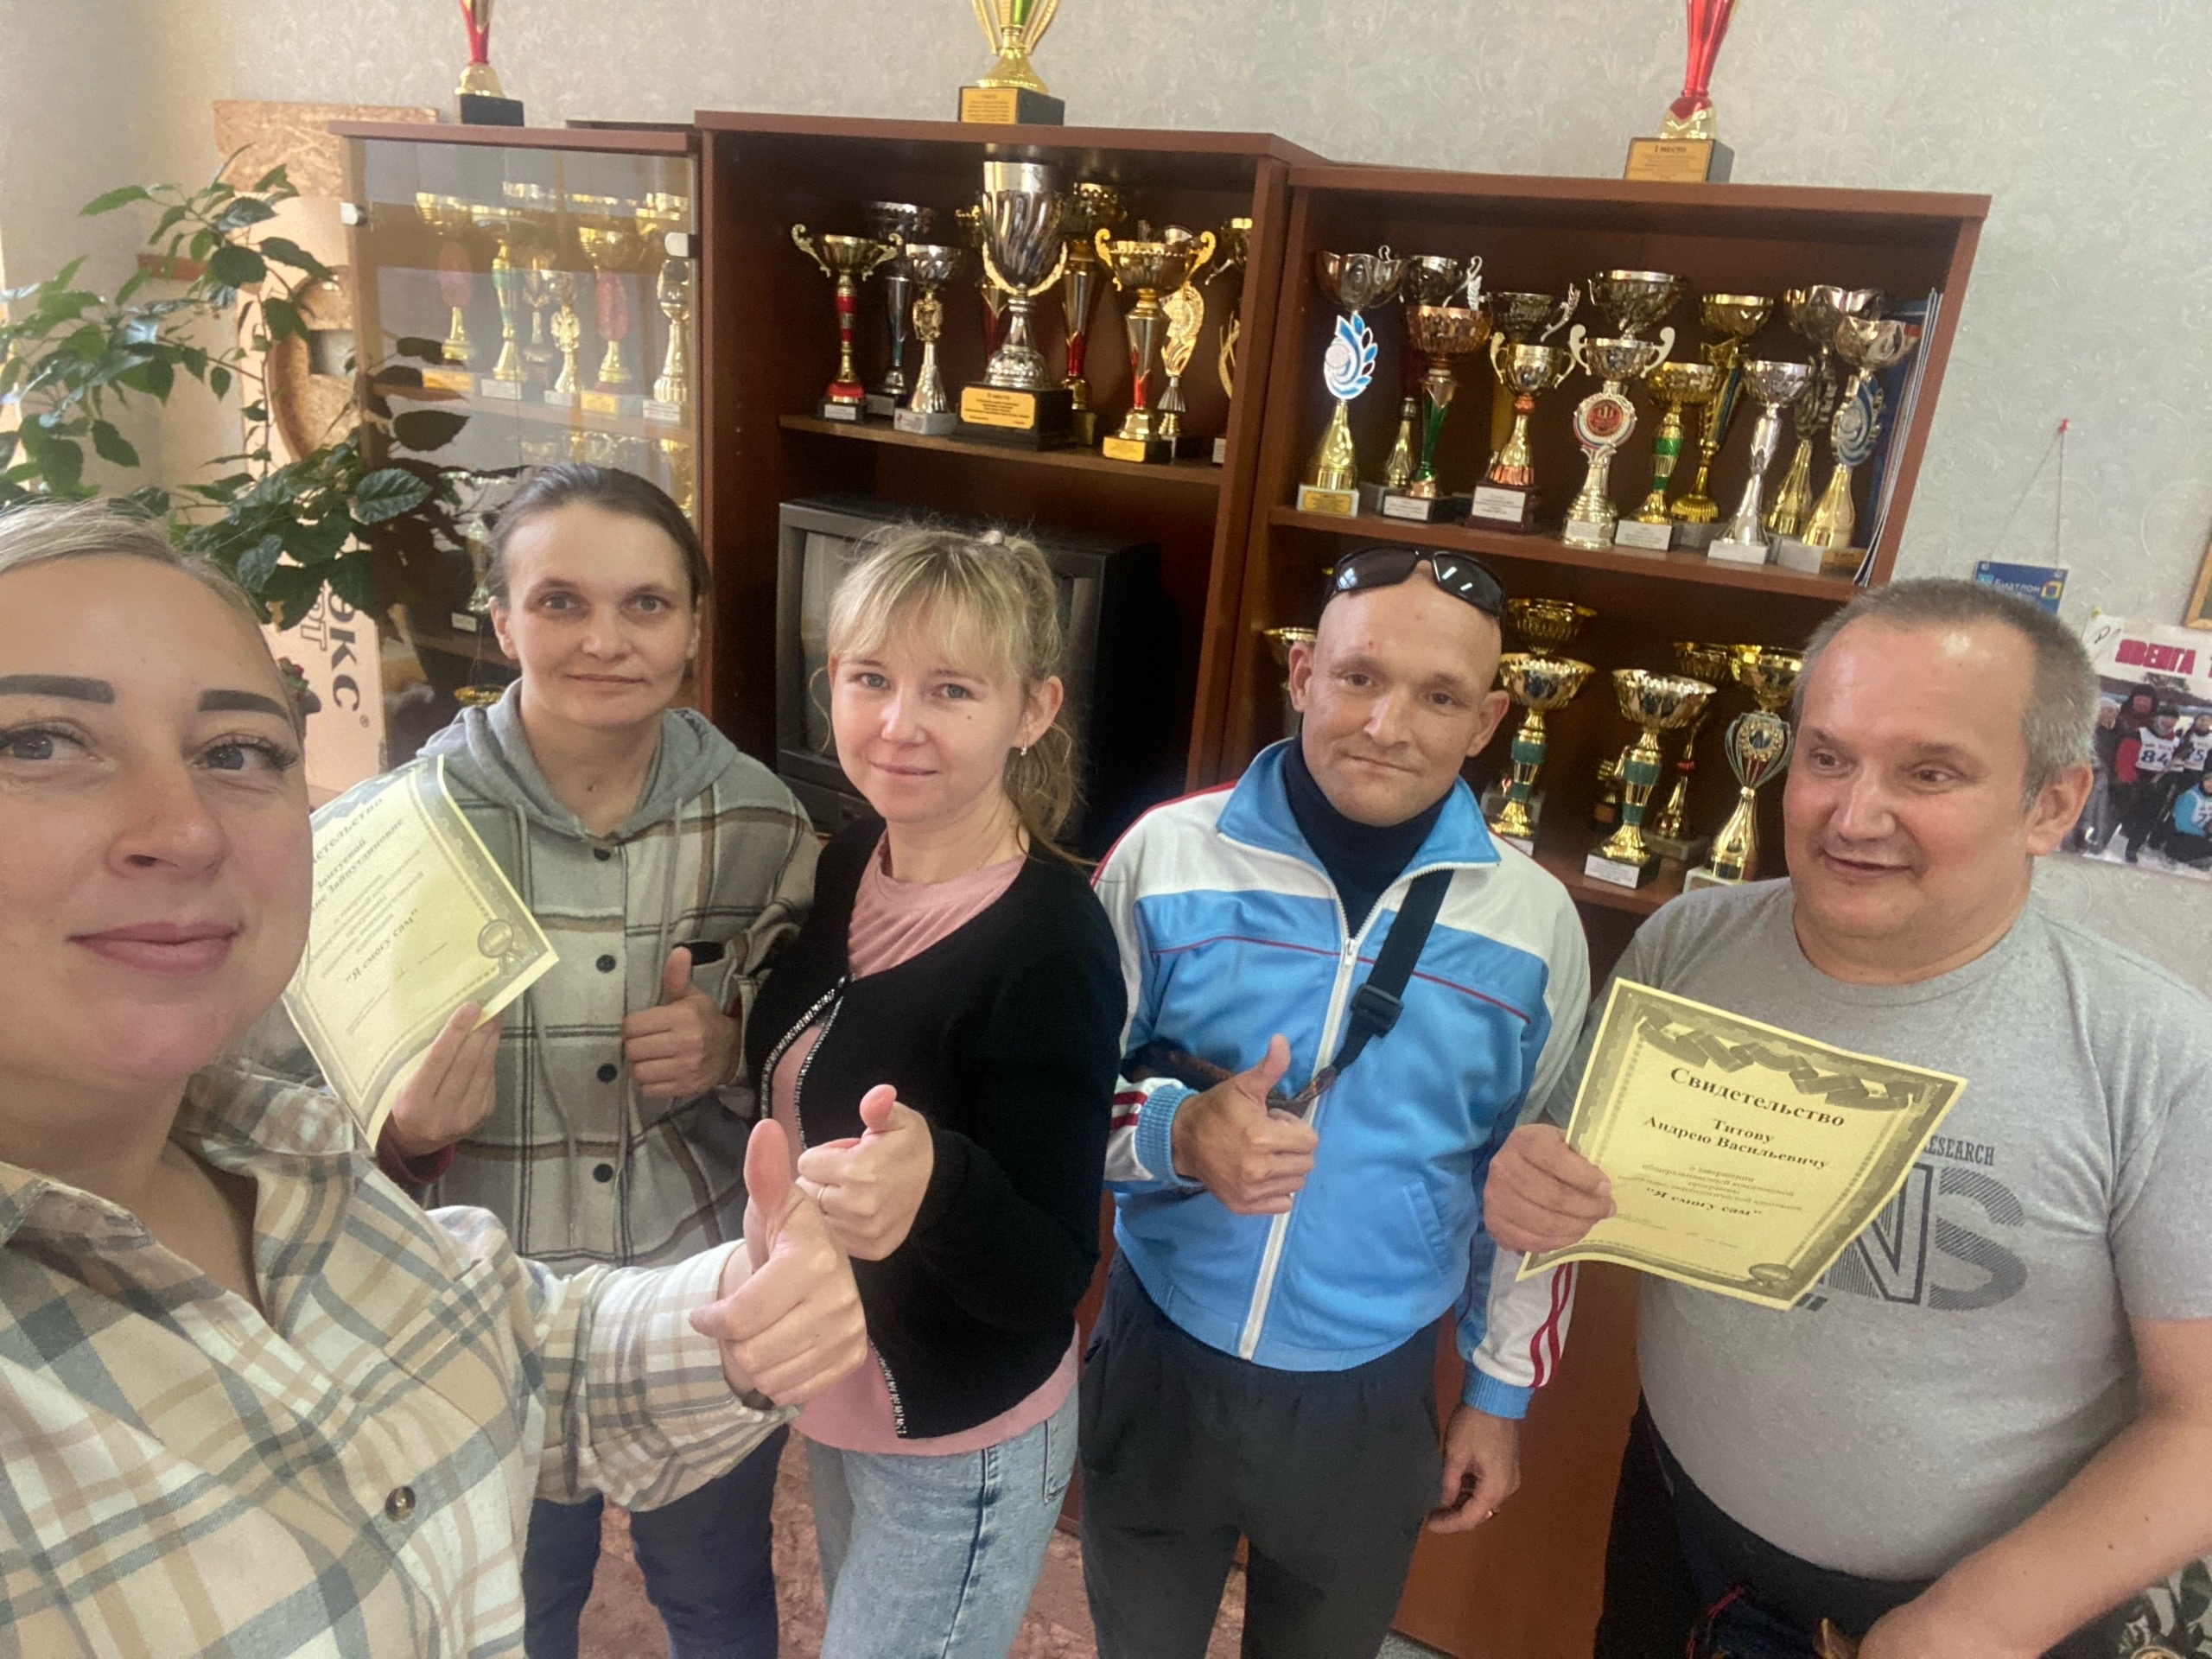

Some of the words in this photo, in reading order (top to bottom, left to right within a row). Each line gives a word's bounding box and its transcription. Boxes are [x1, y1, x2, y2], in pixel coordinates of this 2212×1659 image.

[315, 798, 383, 863] етельство
[363, 940, 391, 969] смогу
[1670, 1067, 1845, 1127] Свидетельство
[1643, 1116, 1712, 1144] Андрею
[1716, 1137, 1830, 1170] Васильевичу
[1713, 1118, 1775, 1144] Титову
[1923, 1135, 1994, 1166] ESEARCH
[1671, 1195, 1714, 1211] смогу
